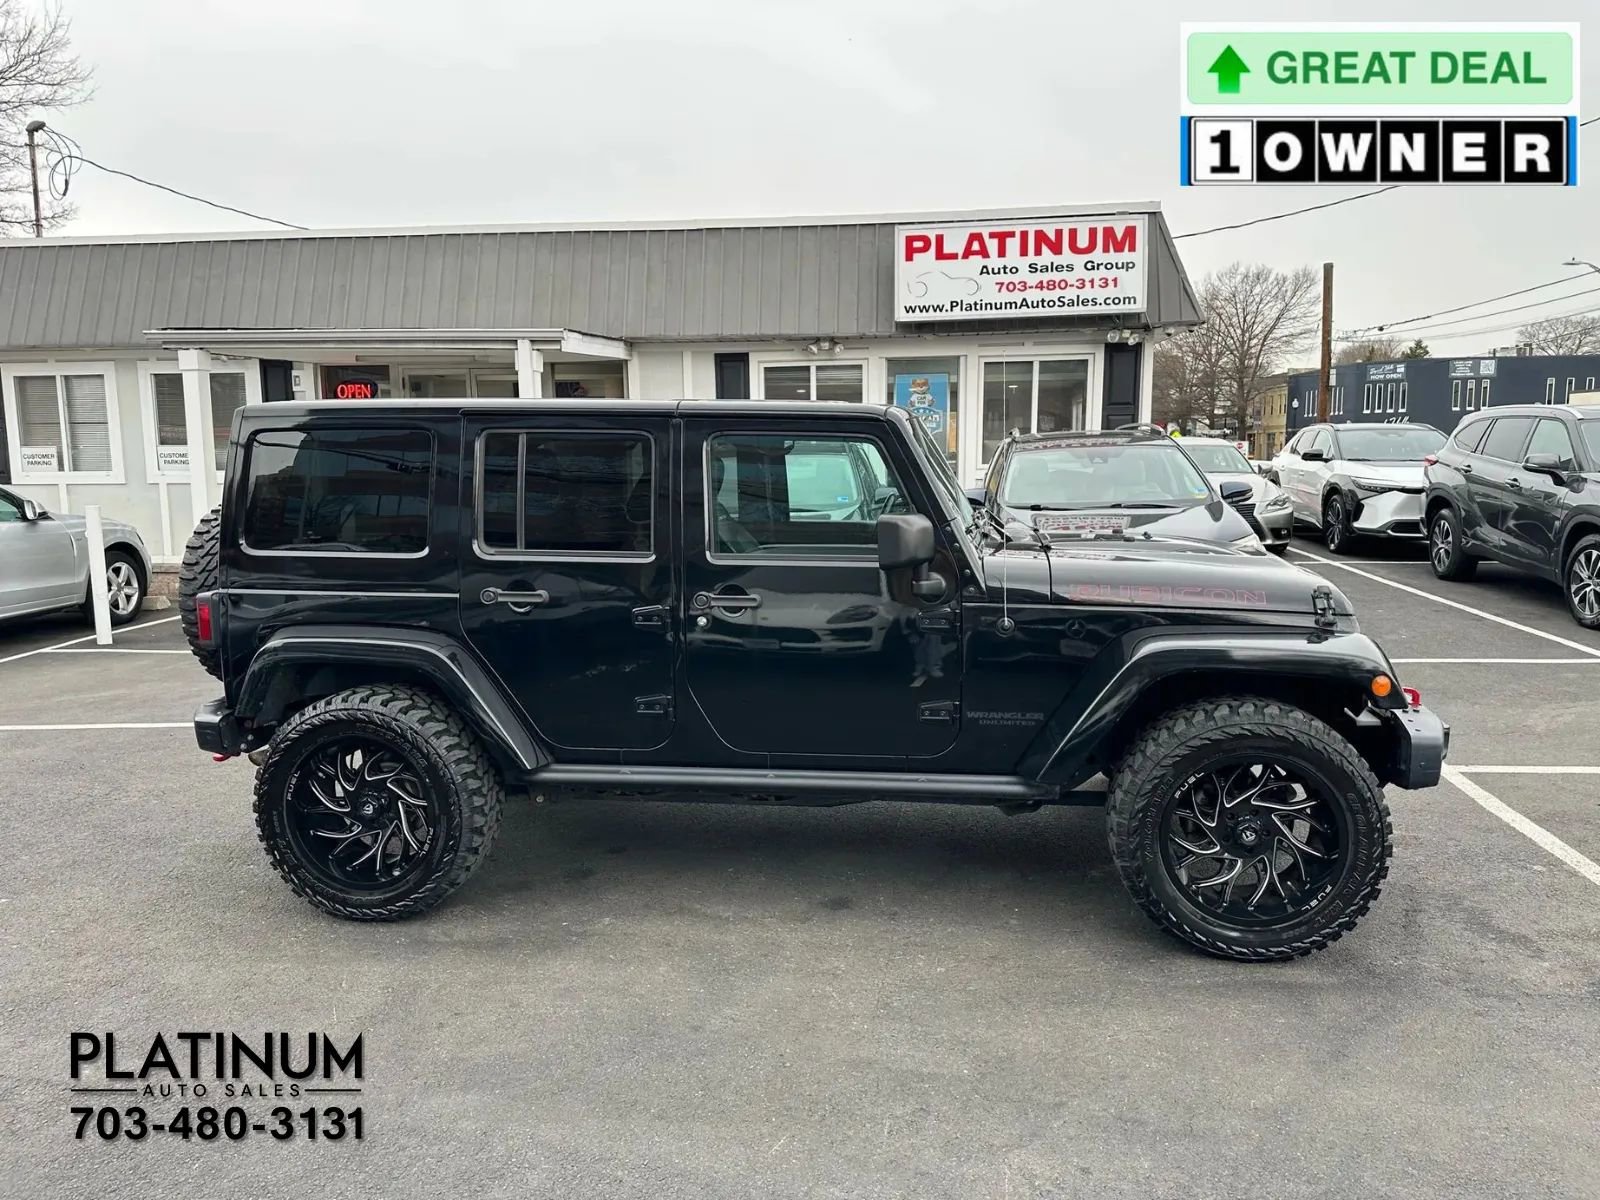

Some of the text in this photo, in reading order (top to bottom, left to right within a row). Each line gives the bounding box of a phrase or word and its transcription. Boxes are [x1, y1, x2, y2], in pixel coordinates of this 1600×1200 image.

[904, 225, 1137, 262] PLATINUM
[979, 260, 1136, 276] Auto Sales Group
[994, 277, 1119, 293] 703-480-3131
[904, 294, 1137, 314] www.PlatinumAutoSales.com
[337, 384, 371, 399] OPEN
[966, 711, 1045, 720] WRANGLER
[1174, 771, 1204, 799] FUEL
[1301, 884, 1334, 912] FUEL
